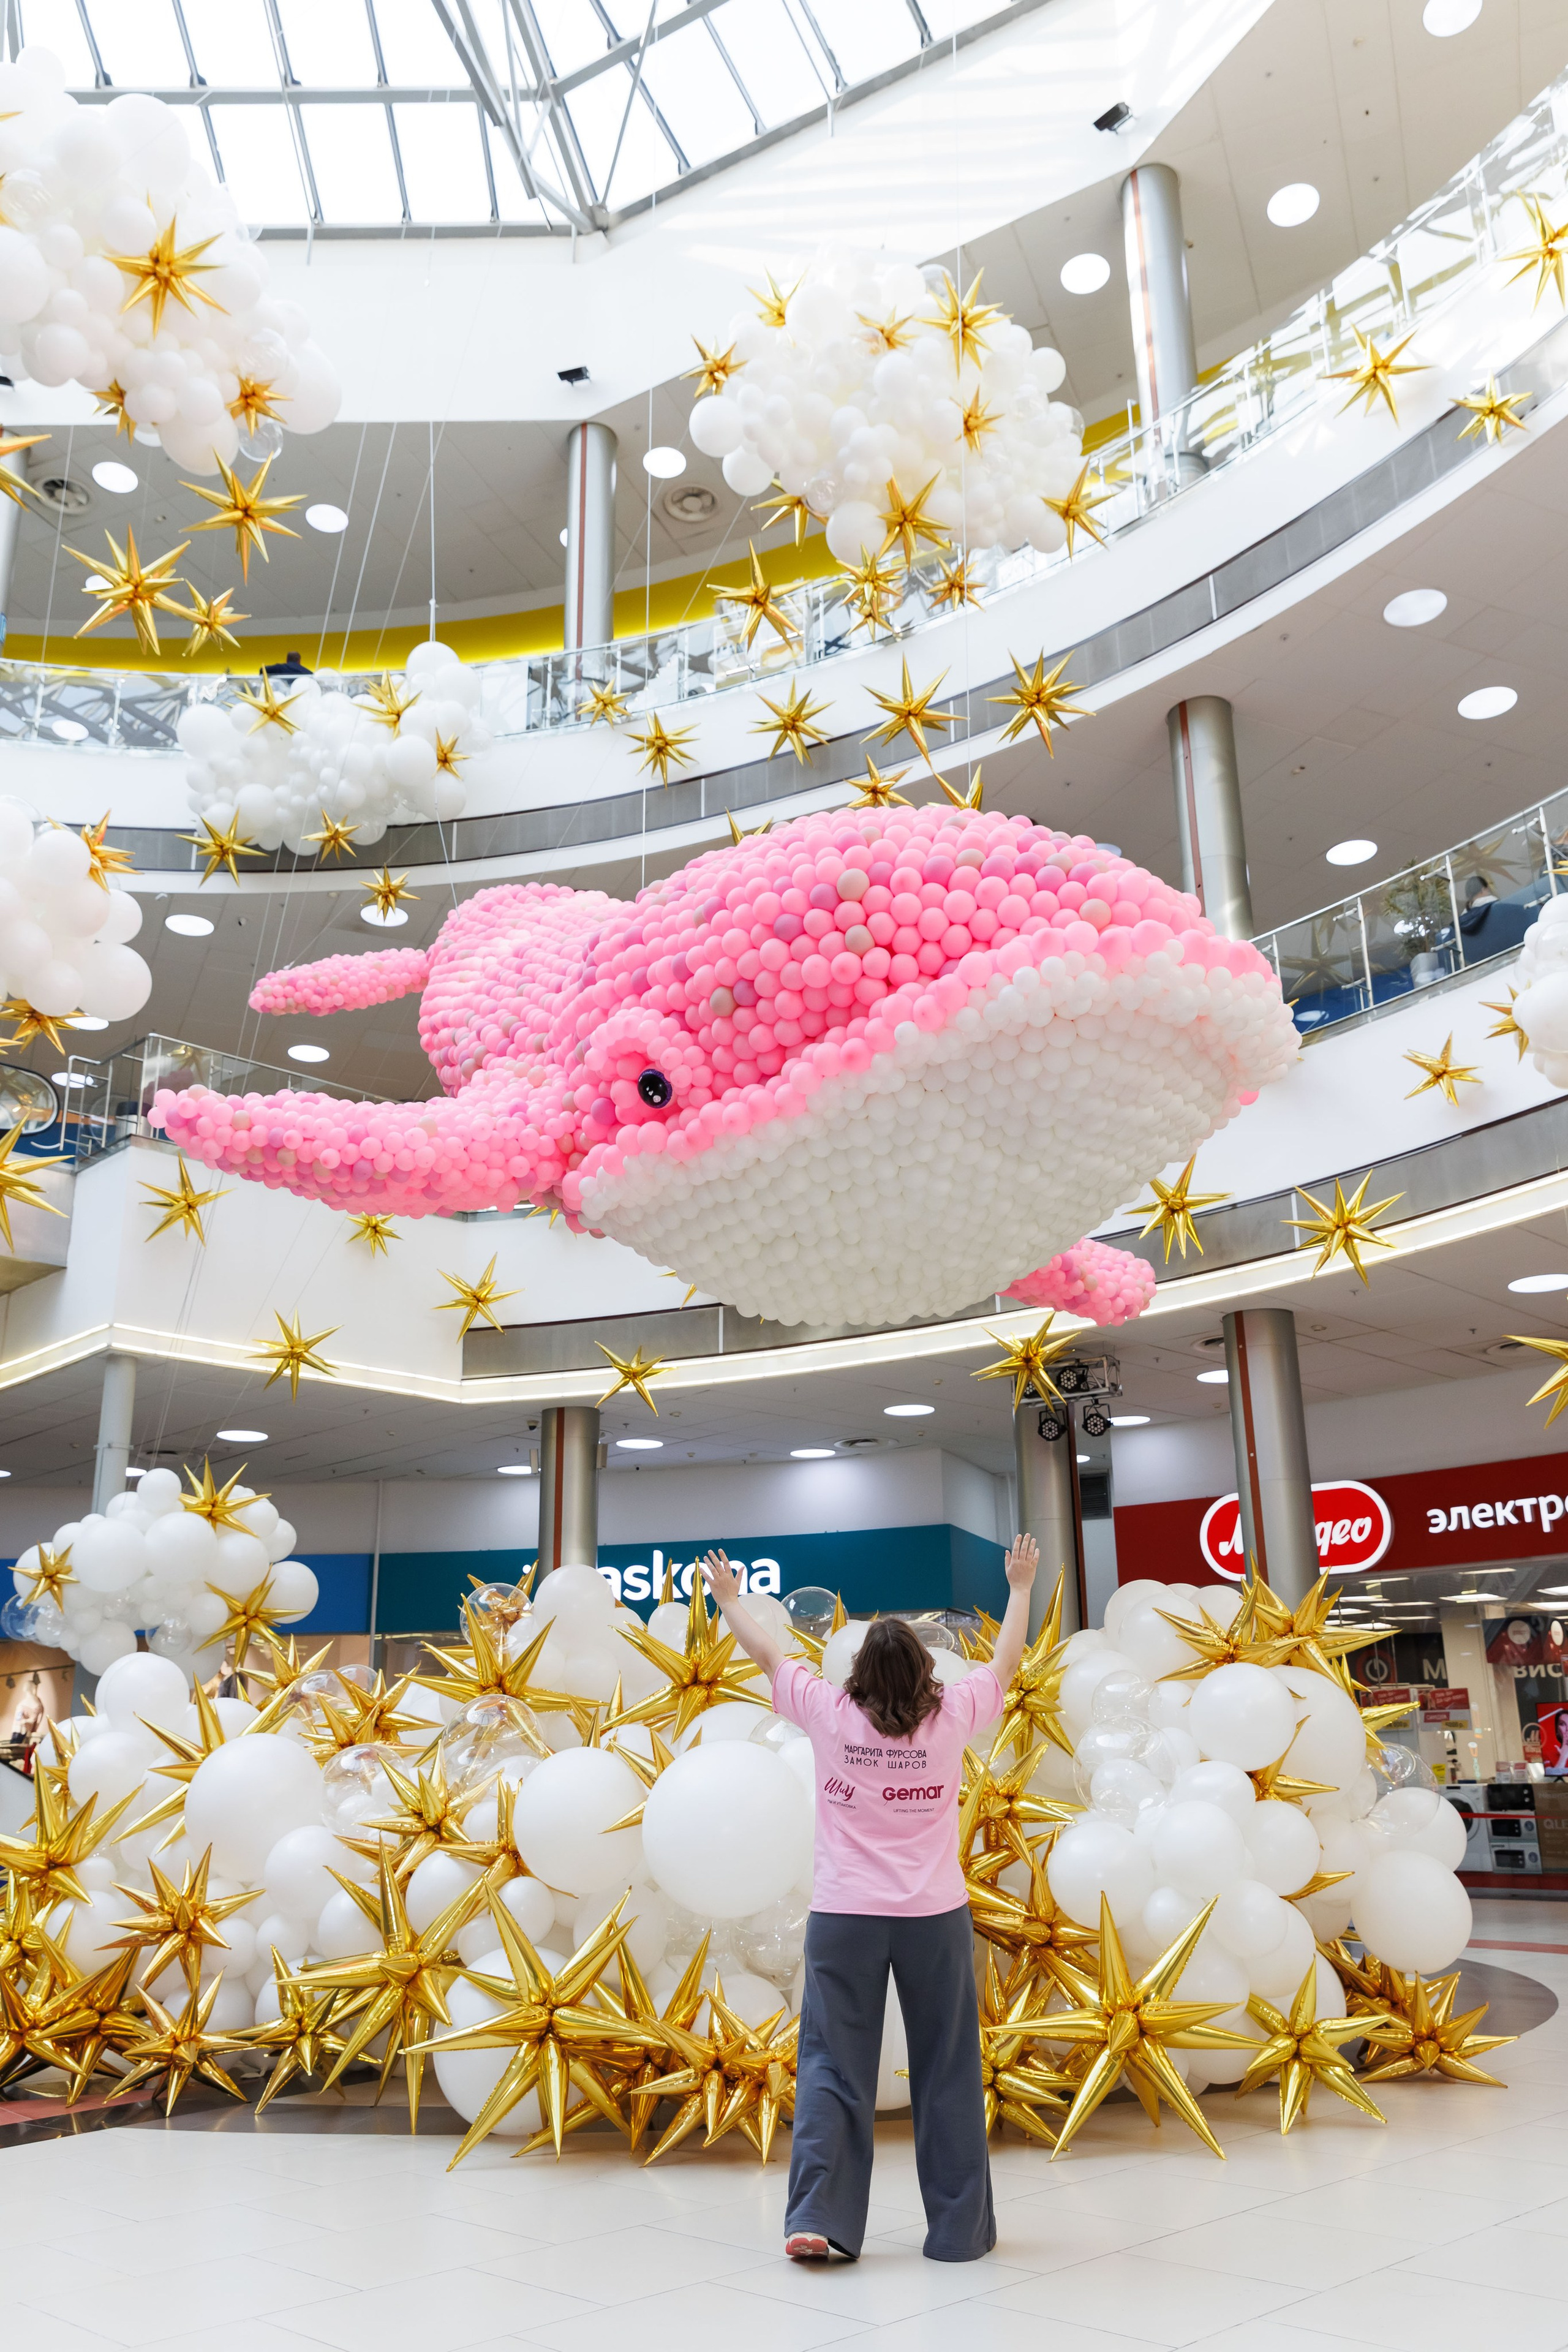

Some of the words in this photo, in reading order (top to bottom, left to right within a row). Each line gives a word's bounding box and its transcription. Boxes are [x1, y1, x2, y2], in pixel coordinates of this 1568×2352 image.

[1426, 1493, 1568, 1534] электр
[844, 1744, 883, 1757] МАРГАРИТА
[886, 1749, 927, 1759] ФУРСОВА
[844, 1755, 878, 1767] ЗАМОК
[888, 1760, 927, 1769] ШАРОВ
[882, 1785, 944, 1801] Gemar
